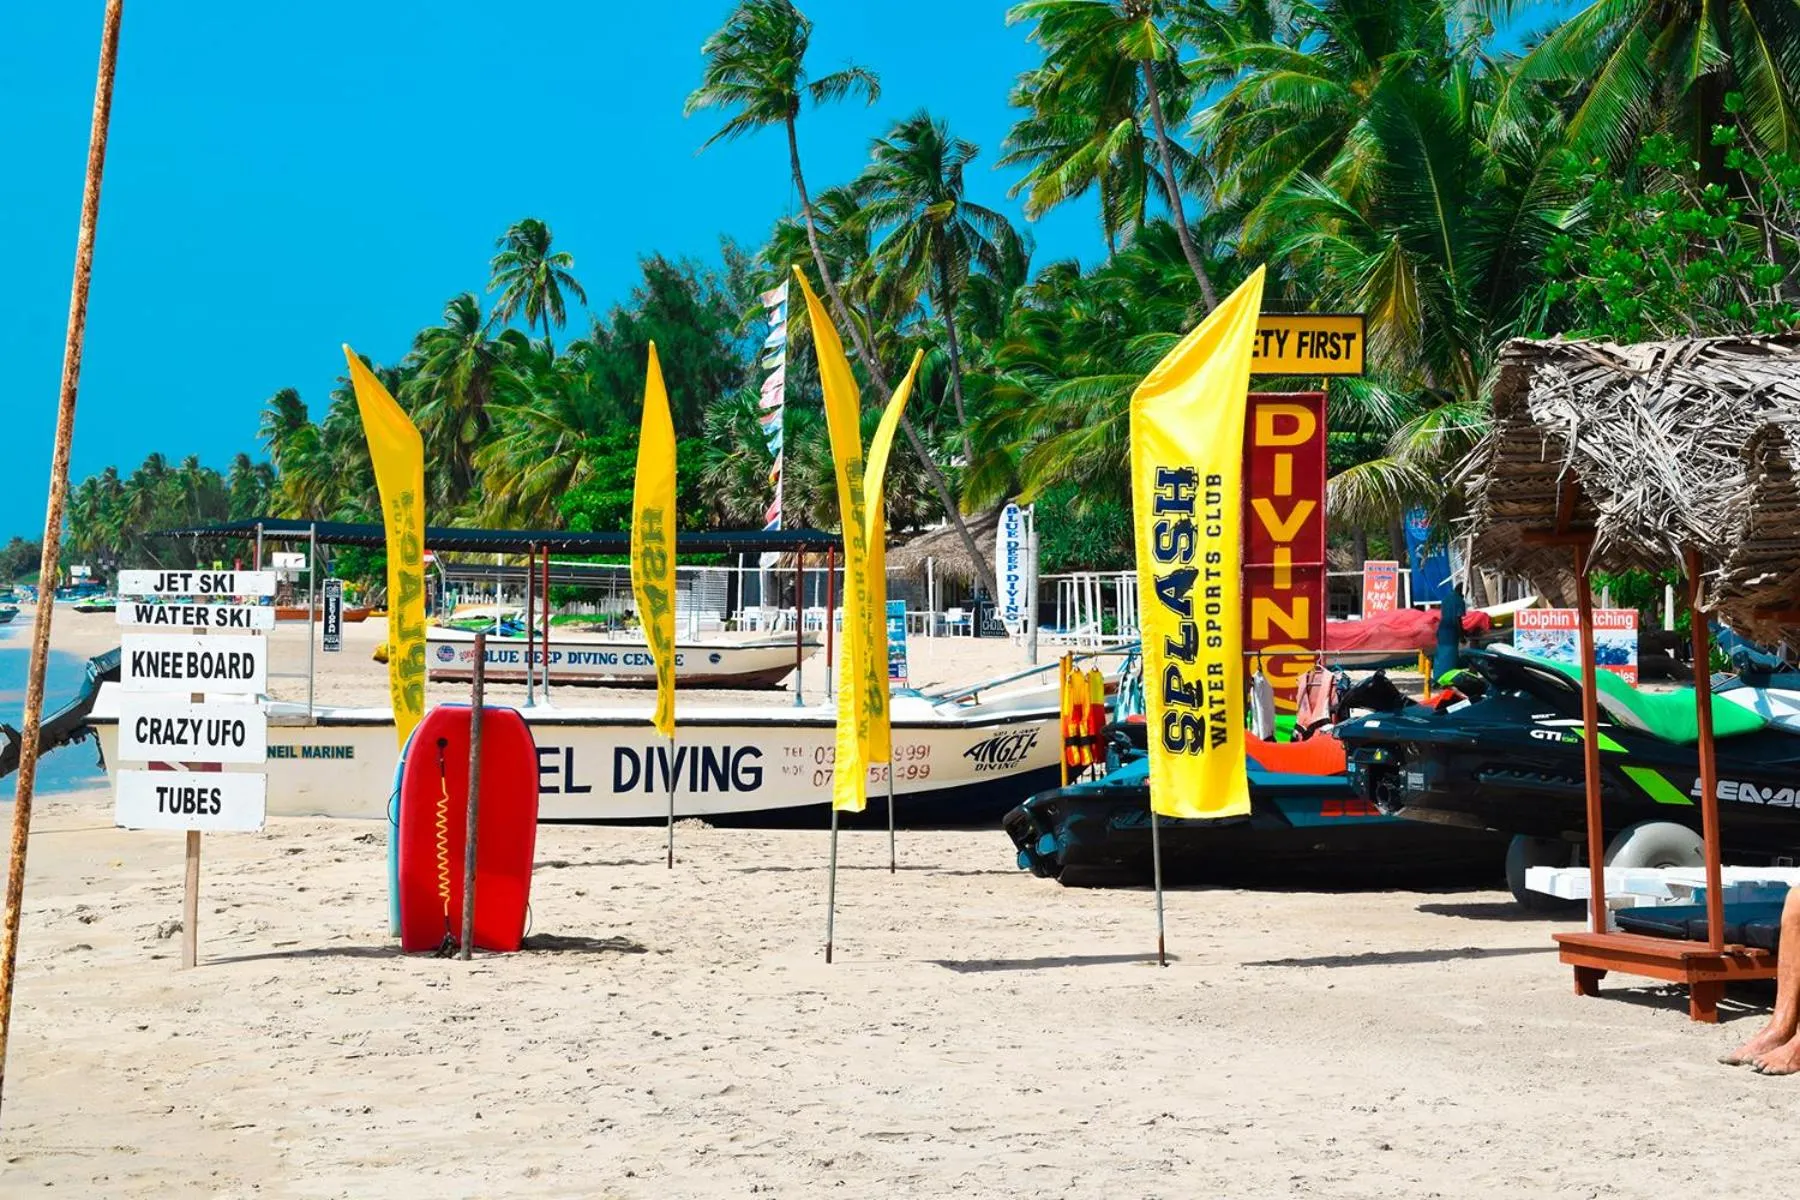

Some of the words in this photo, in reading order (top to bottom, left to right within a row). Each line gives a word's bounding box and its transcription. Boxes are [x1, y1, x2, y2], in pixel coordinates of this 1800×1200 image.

[1252, 329, 1290, 358] ETY
[1297, 330, 1357, 360] FIRST
[1205, 472, 1223, 538] CLUB
[1005, 507, 1018, 538] BLUE
[1006, 540, 1019, 571] DEEP
[1250, 403, 1317, 689] DIVING
[153, 573, 192, 592] JET
[199, 573, 235, 593] SKI
[1006, 574, 1019, 621] DIVING
[1152, 465, 1207, 757] SPLASH
[1205, 551, 1223, 648] SPORTS
[135, 604, 210, 626] WATER
[215, 607, 252, 628] SKI
[1520, 611, 1570, 629] Dolphin
[1573, 611, 1633, 629] tching
[482, 650, 519, 664] BLUE
[567, 652, 619, 666] DIVING
[623, 653, 684, 667] CENE
[1208, 661, 1227, 750] WATER
[135, 716, 203, 746] CRAZY
[207, 718, 246, 747] UFO
[267, 745, 298, 759] NEIL
[302, 745, 354, 759] MARINE
[963, 733, 1038, 763] ANGEL
[535, 746, 593, 794] EL
[613, 745, 763, 793] DIVING
[975, 762, 1018, 772] DIVING
[155, 786, 222, 815] TUBES
